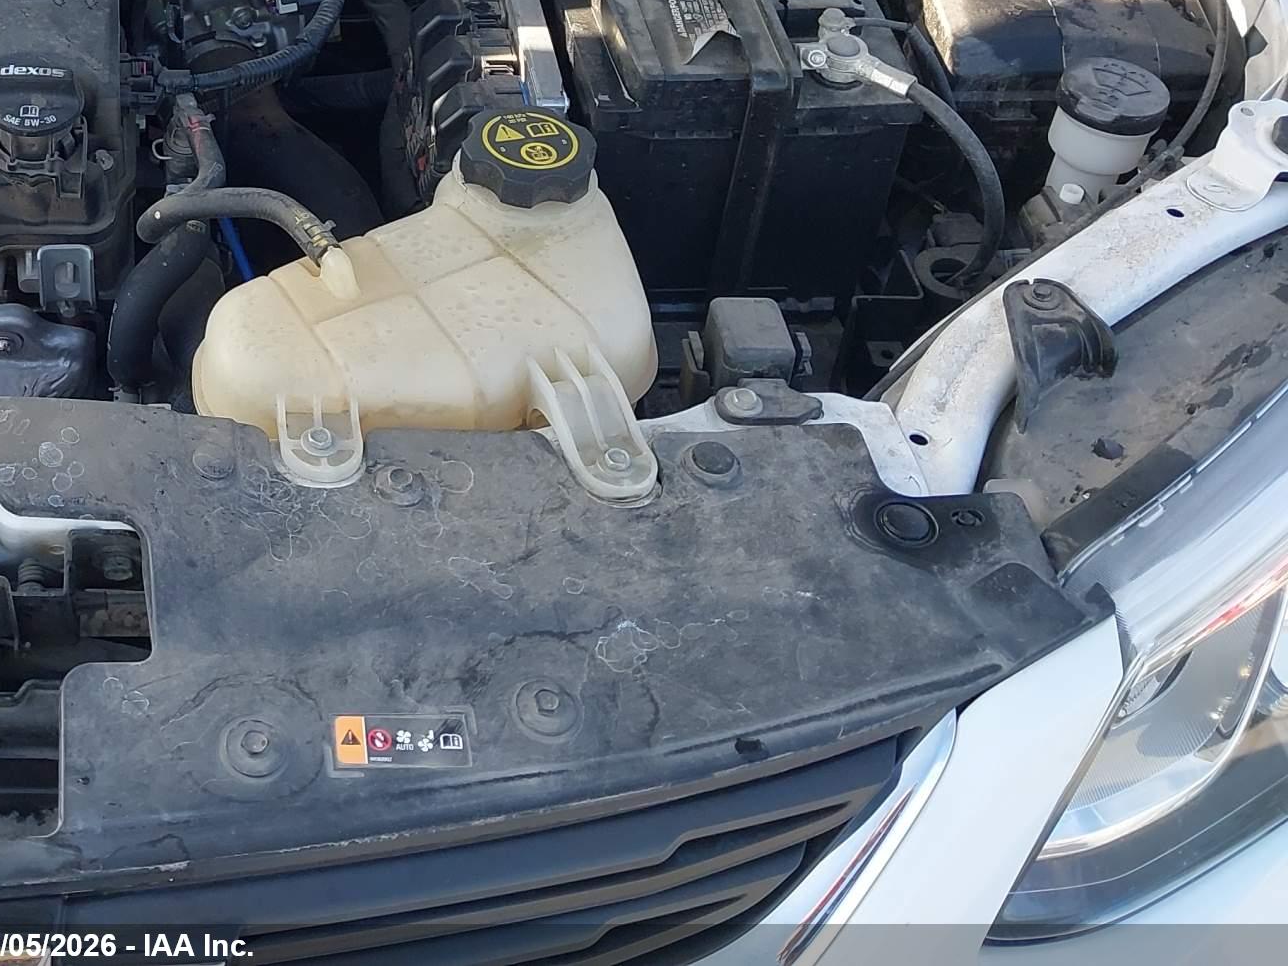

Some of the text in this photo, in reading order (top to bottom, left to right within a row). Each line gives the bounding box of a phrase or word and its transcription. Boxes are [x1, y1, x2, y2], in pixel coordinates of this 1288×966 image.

[0, 64, 67, 78] dexos
[2, 114, 57, 127] SAE 5W-30
[395, 743, 414, 751] AUTO
